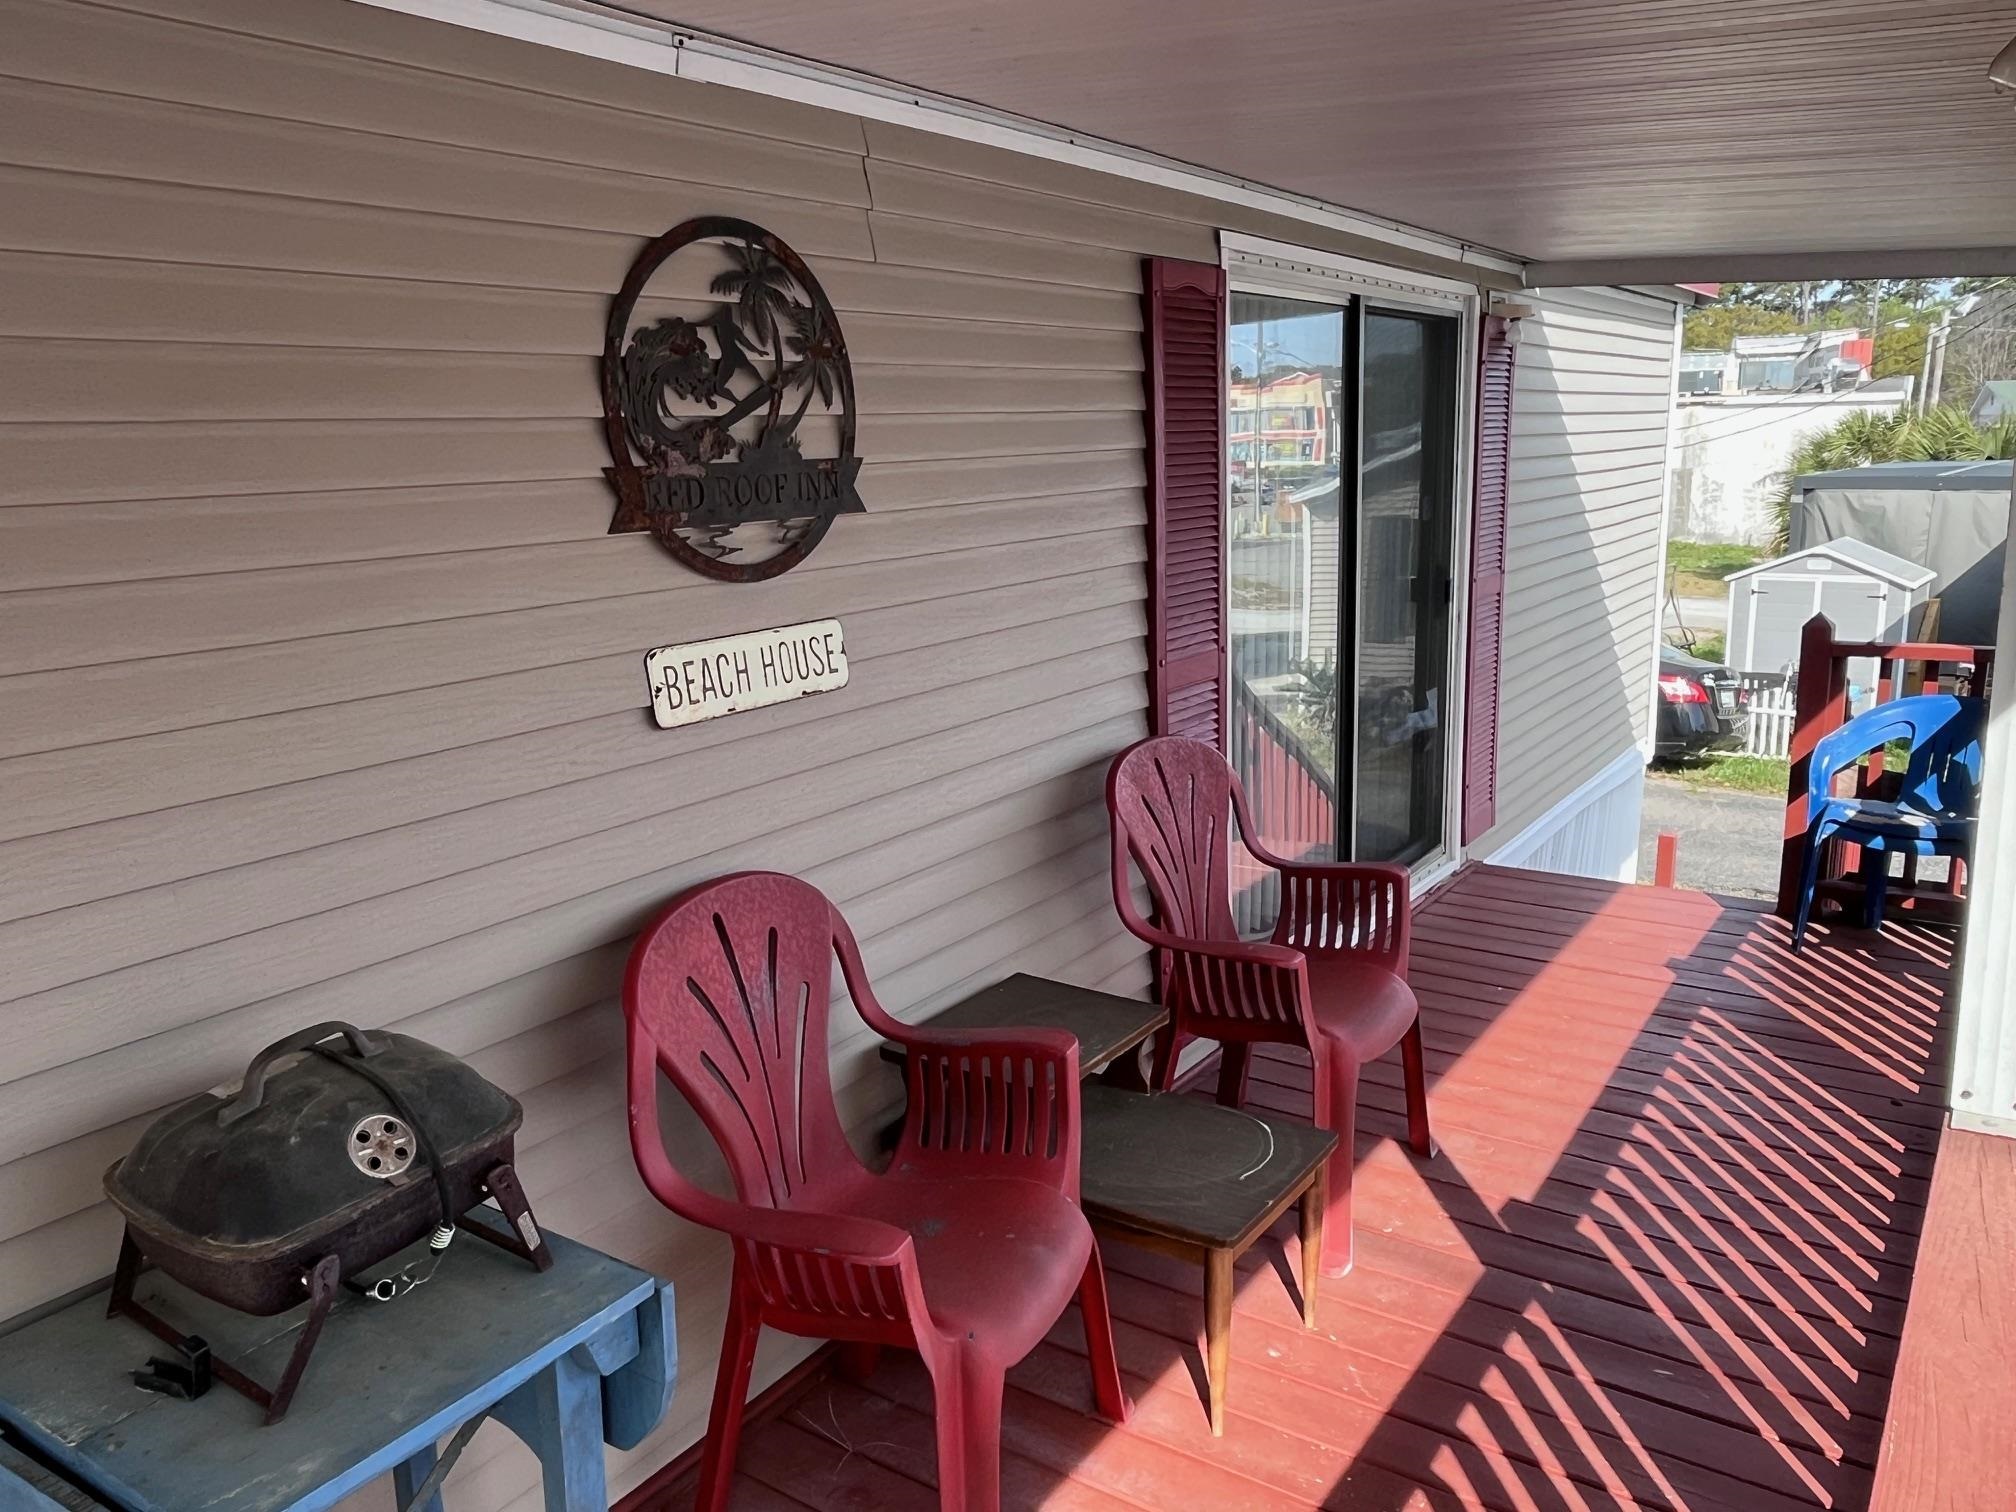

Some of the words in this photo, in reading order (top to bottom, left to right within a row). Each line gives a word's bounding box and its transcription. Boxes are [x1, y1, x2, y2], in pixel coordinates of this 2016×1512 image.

[645, 477, 704, 511] RED
[715, 473, 787, 507] ROOF
[796, 470, 839, 502] INN
[663, 650, 751, 710] BEACH
[761, 633, 839, 688] HOUSE
